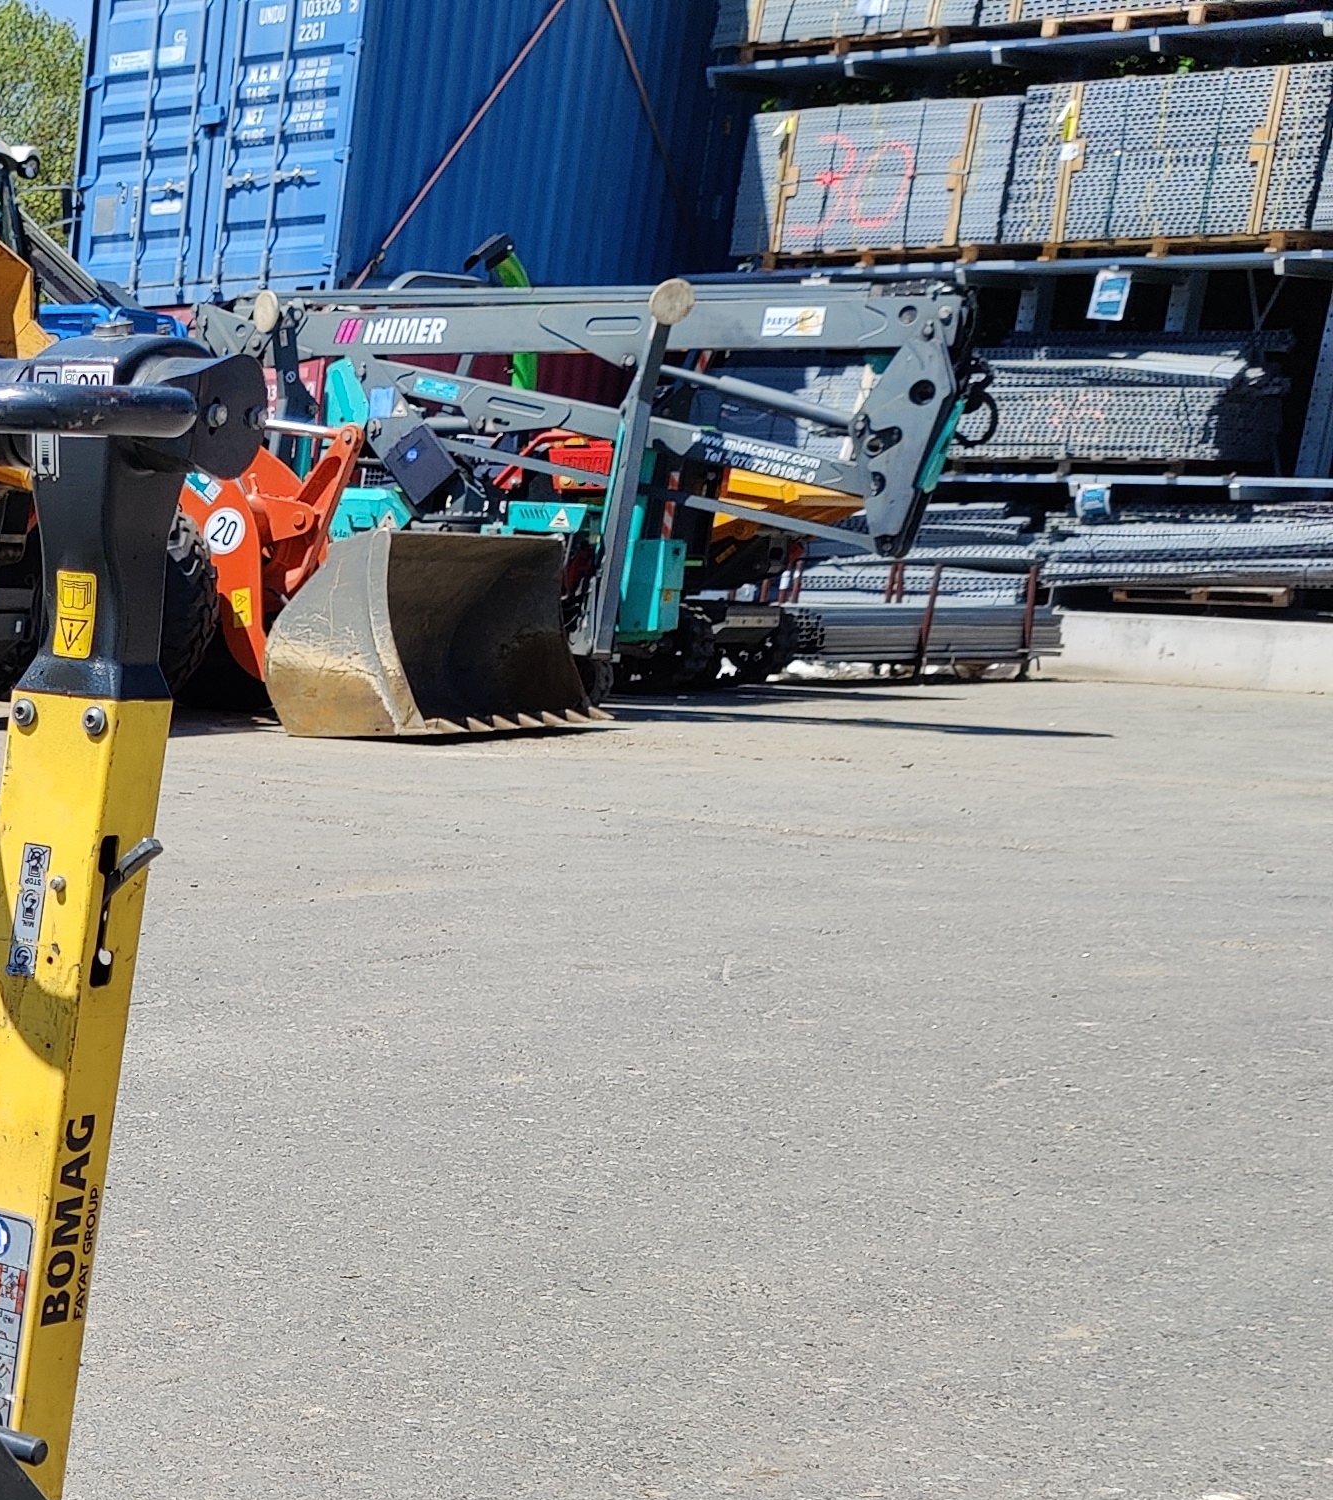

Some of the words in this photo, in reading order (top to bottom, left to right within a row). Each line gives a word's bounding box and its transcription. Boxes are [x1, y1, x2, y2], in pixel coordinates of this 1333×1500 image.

[258, 4, 287, 26] UNDU
[789, 133, 915, 237] 30
[691, 431, 822, 469] www.mietcenter.com
[211, 516, 238, 546] 20
[24, 877, 42, 887] STOP
[40, 1113, 96, 1327] BOMAG
[73, 1263, 90, 1320] FAYAT
[83, 1186, 100, 1255] GROUP
